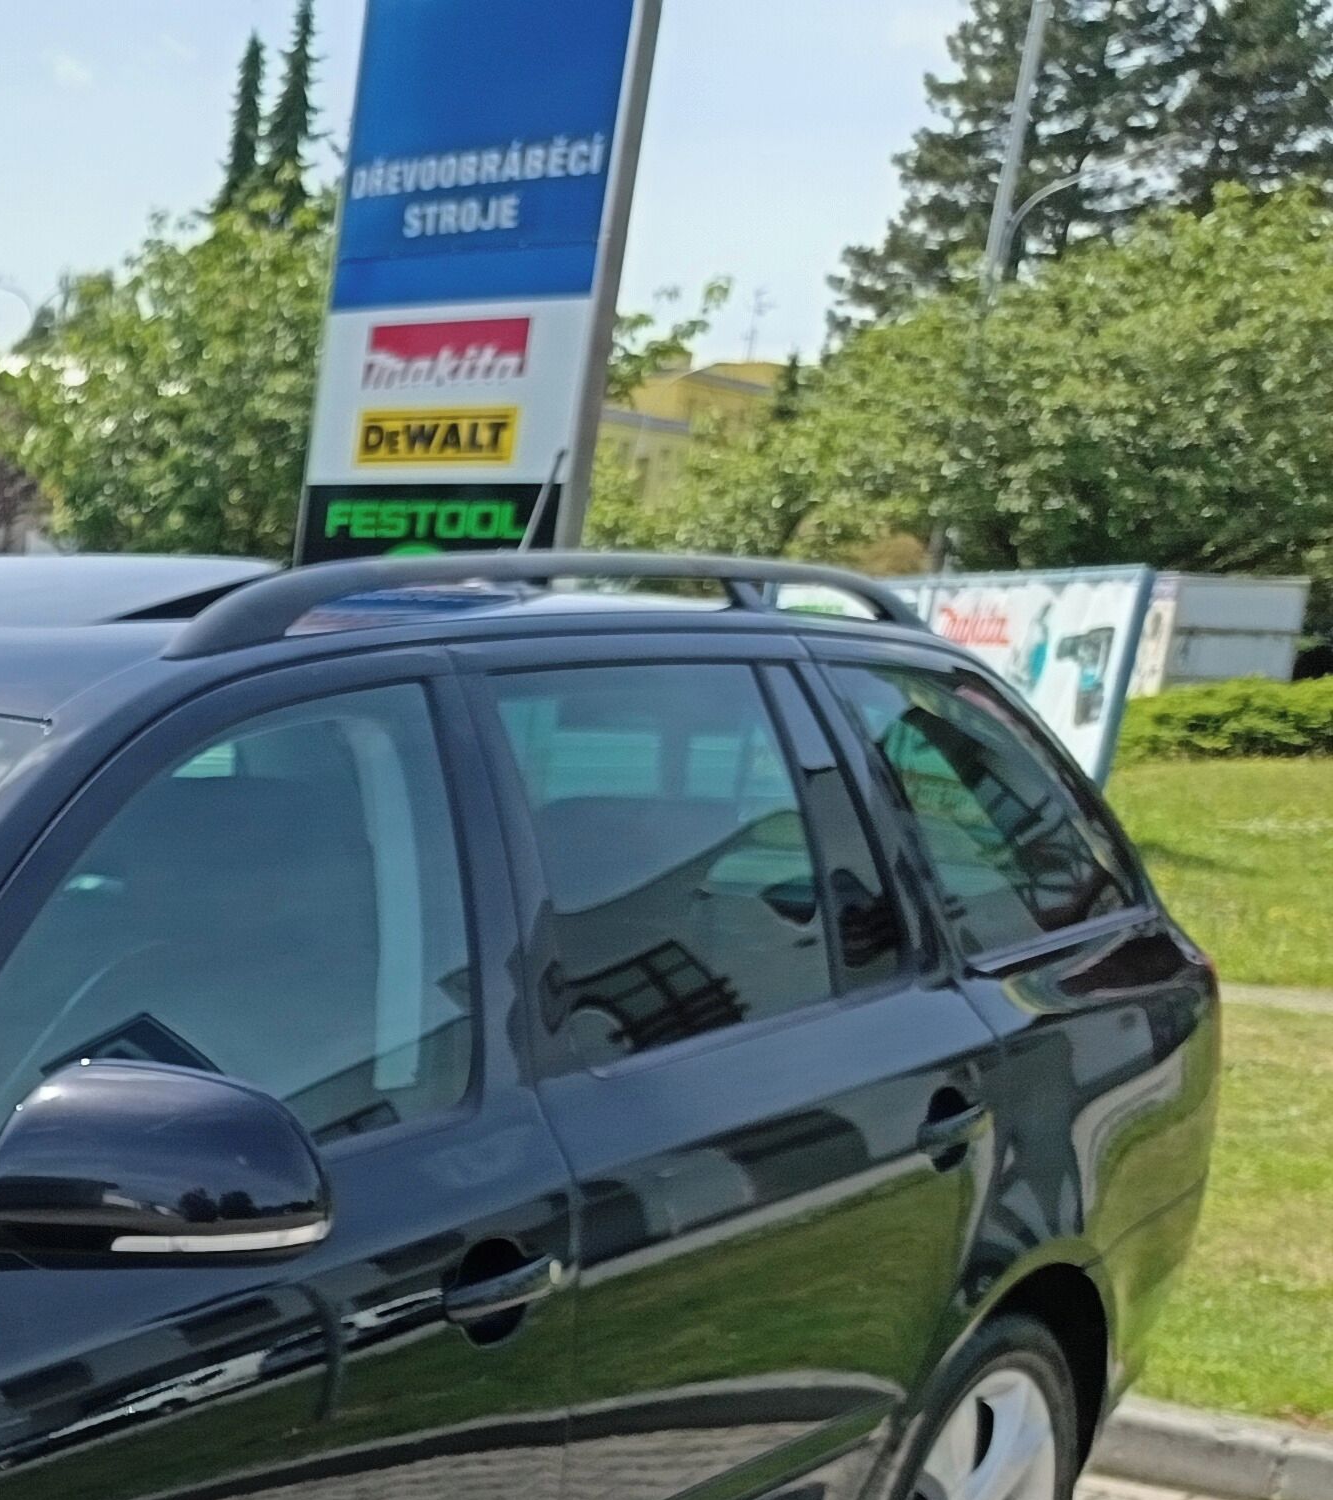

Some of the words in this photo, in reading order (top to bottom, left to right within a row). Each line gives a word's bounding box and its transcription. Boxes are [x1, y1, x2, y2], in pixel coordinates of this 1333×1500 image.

[351, 132, 605, 200] DŘEVOOBRÁBĚCÍ
[402, 192, 521, 239] STROJE
[325, 501, 528, 540] FESTOOL
